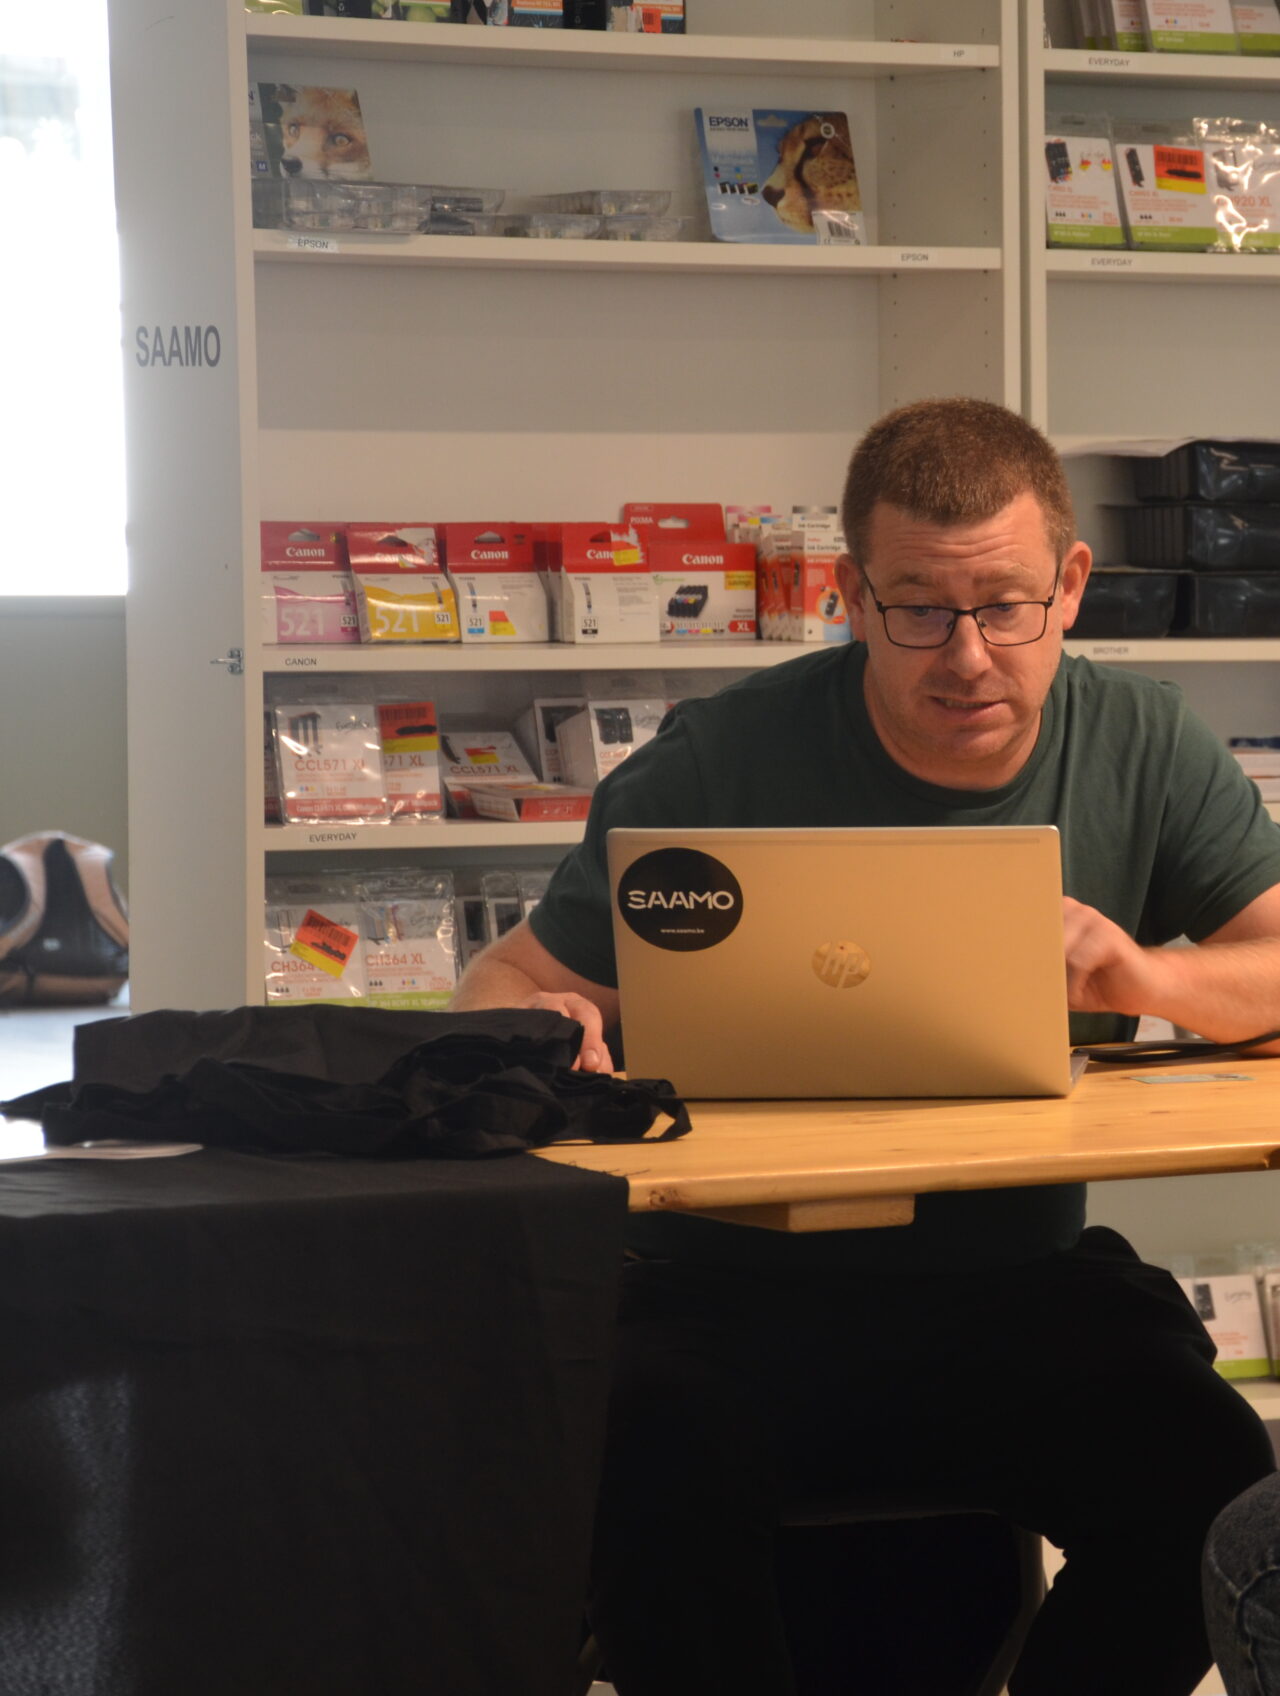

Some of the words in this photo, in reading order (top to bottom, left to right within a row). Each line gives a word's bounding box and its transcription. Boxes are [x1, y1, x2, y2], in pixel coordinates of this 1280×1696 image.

[1088, 57, 1130, 67] EVERYDAY
[709, 116, 748, 128] EPSON
[297, 238, 329, 249] EPSON
[901, 253, 929, 261] EPSON
[1091, 257, 1133, 267] EVERYDAY
[135, 325, 221, 368] SAAMO
[286, 546, 325, 558] Canon
[470, 549, 509, 560] Canon
[682, 553, 724, 565] Canon
[280, 608, 324, 636] 521
[342, 615, 356, 625] 521
[375, 606, 421, 633] 521
[436, 614, 449, 623] 521
[469, 617, 482, 627] 521
[583, 617, 597, 628] 521
[737, 621, 750, 632] XL
[1093, 647, 1129, 655] BROTHER
[285, 657, 317, 666] CANON
[409, 755, 424, 766] XL
[309, 832, 358, 843] EVERYDAY
[627, 889, 735, 911] SAAMO
[365, 953, 408, 967] CH364
[410, 952, 427, 965] XL
[818, 940, 866, 990] hp
[271, 960, 315, 973] CH364
